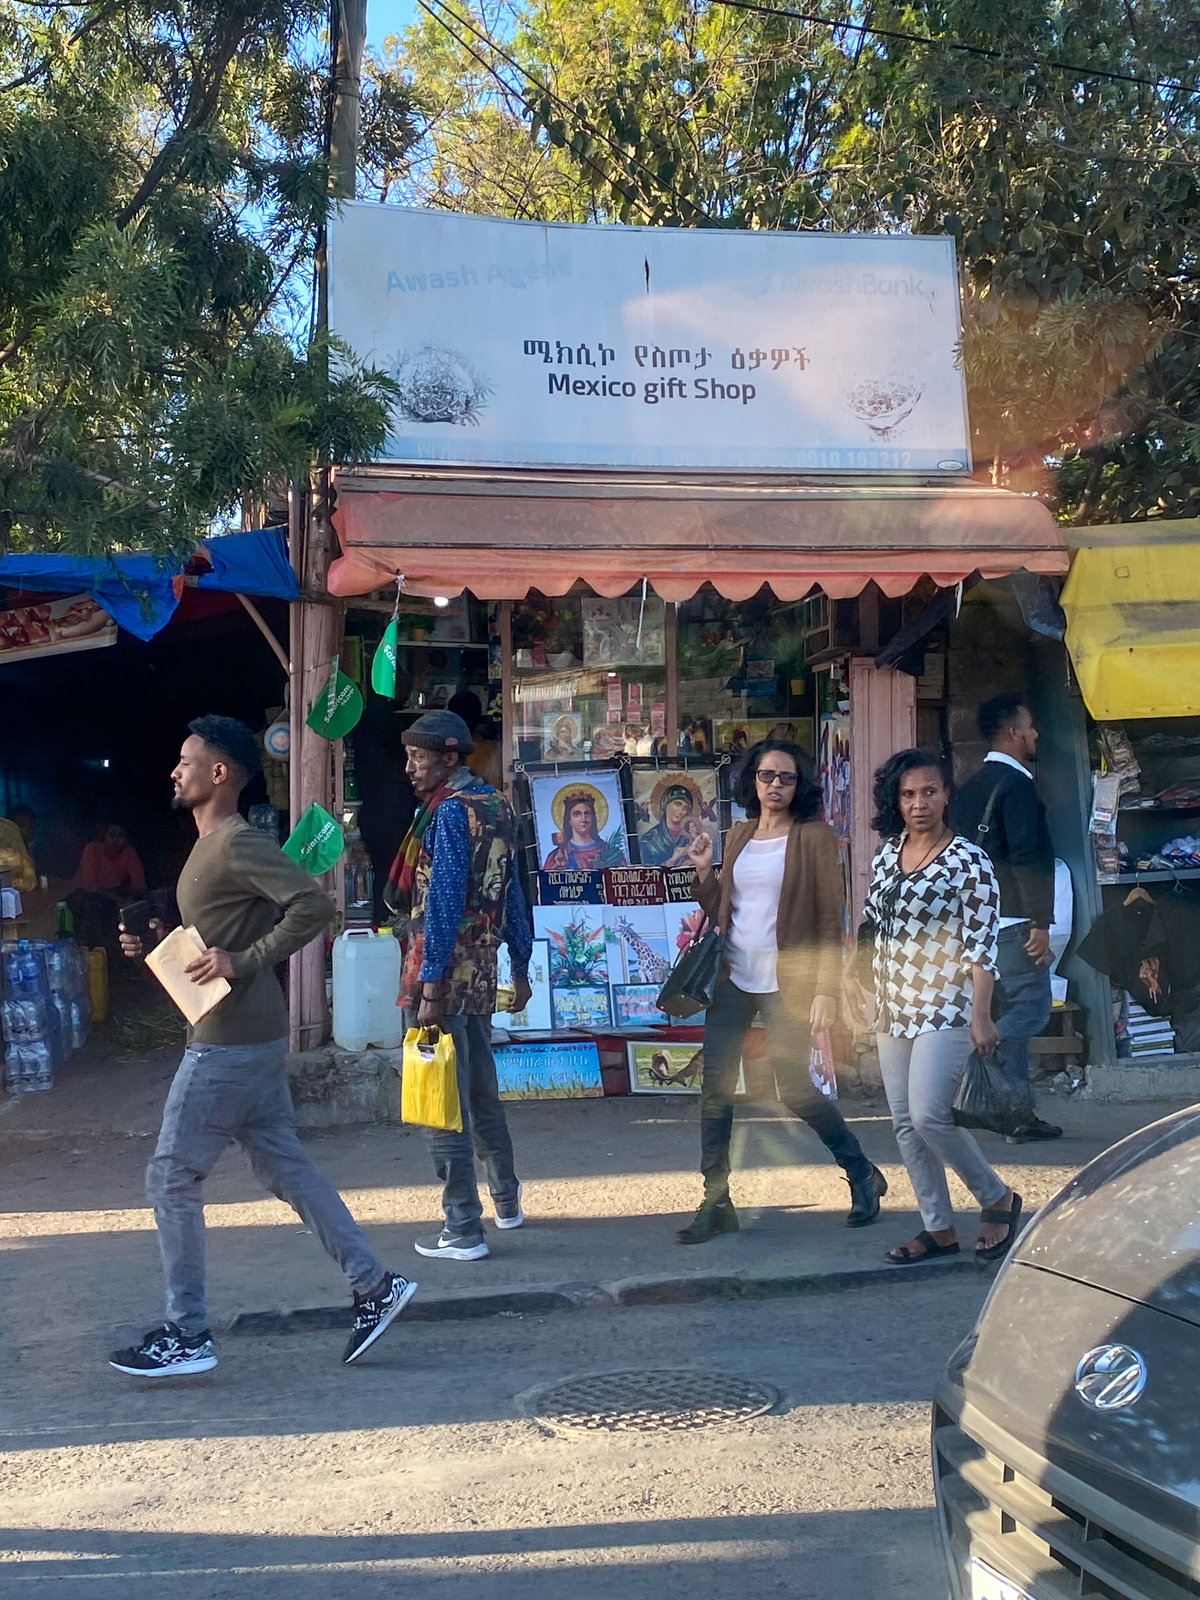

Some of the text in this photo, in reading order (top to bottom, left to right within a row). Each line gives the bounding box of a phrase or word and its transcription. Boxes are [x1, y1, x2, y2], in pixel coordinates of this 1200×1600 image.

[387, 264, 478, 292] Awash
[523, 339, 811, 371] ሜክሲኮ የስጦታ ዕቃዎች
[548, 373, 757, 405] Mexico gift Shop
